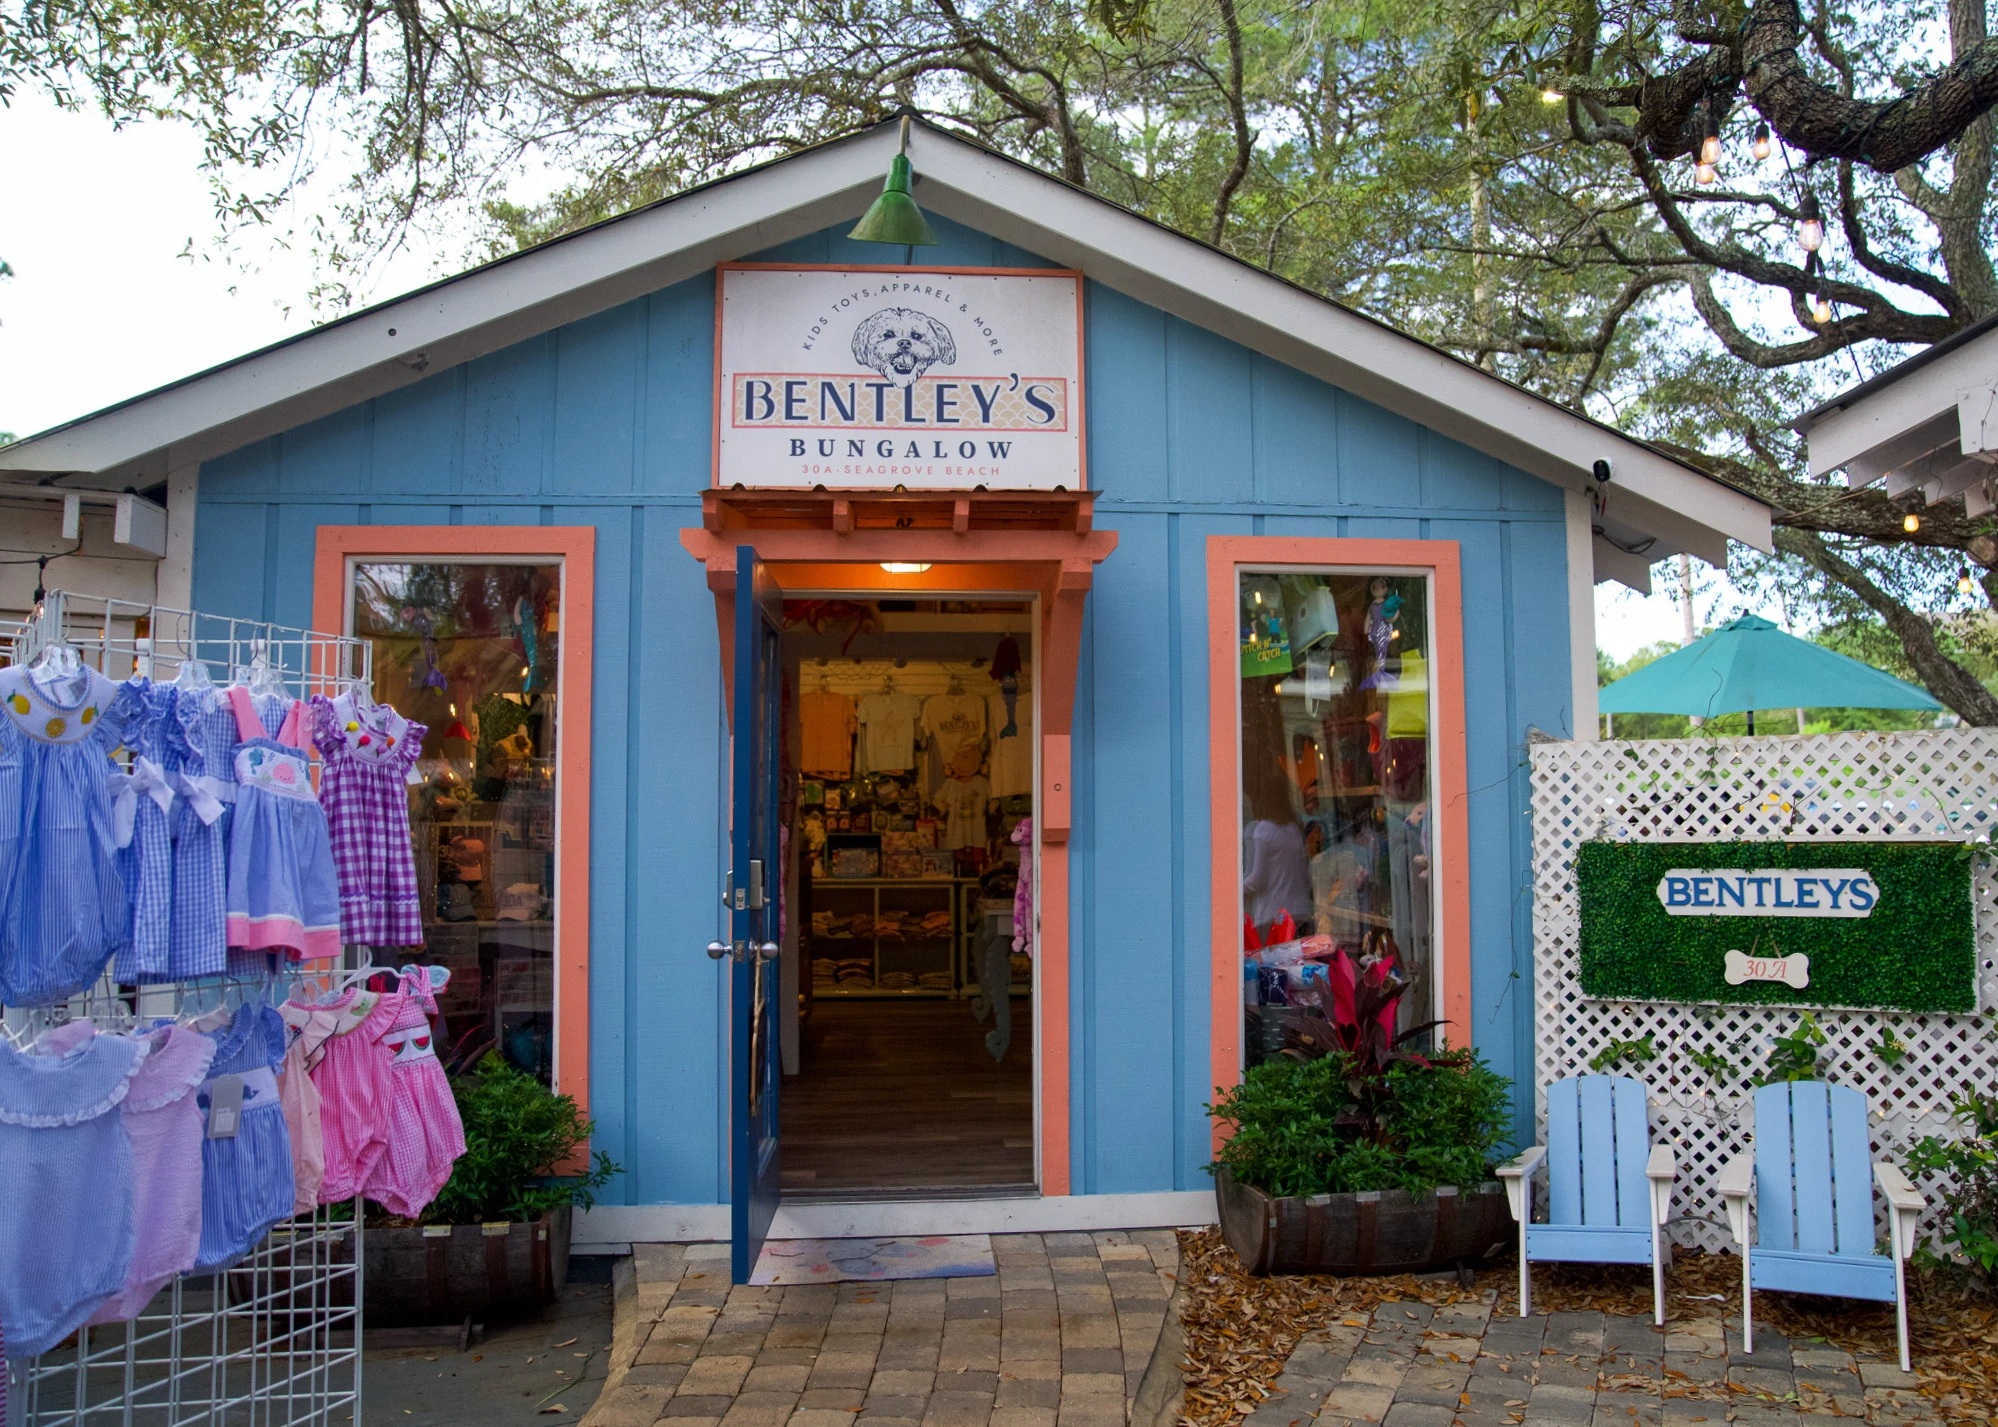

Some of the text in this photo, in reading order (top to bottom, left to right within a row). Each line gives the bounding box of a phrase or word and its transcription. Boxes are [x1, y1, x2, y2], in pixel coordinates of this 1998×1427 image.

[803, 316, 828, 351] KIDS
[881, 283, 951, 303] APPAREL
[959, 303, 968, 313] &
[974, 316, 1003, 356] MORE
[744, 372, 1055, 425] BENTLEY'S
[789, 438, 1012, 460] BUNGALOW
[945, 466, 1000, 476] BEACH
[1257, 647, 1281, 662] CATCH
[1664, 876, 1875, 911] BENTLEYS
[1743, 959, 1787, 979] 30A
